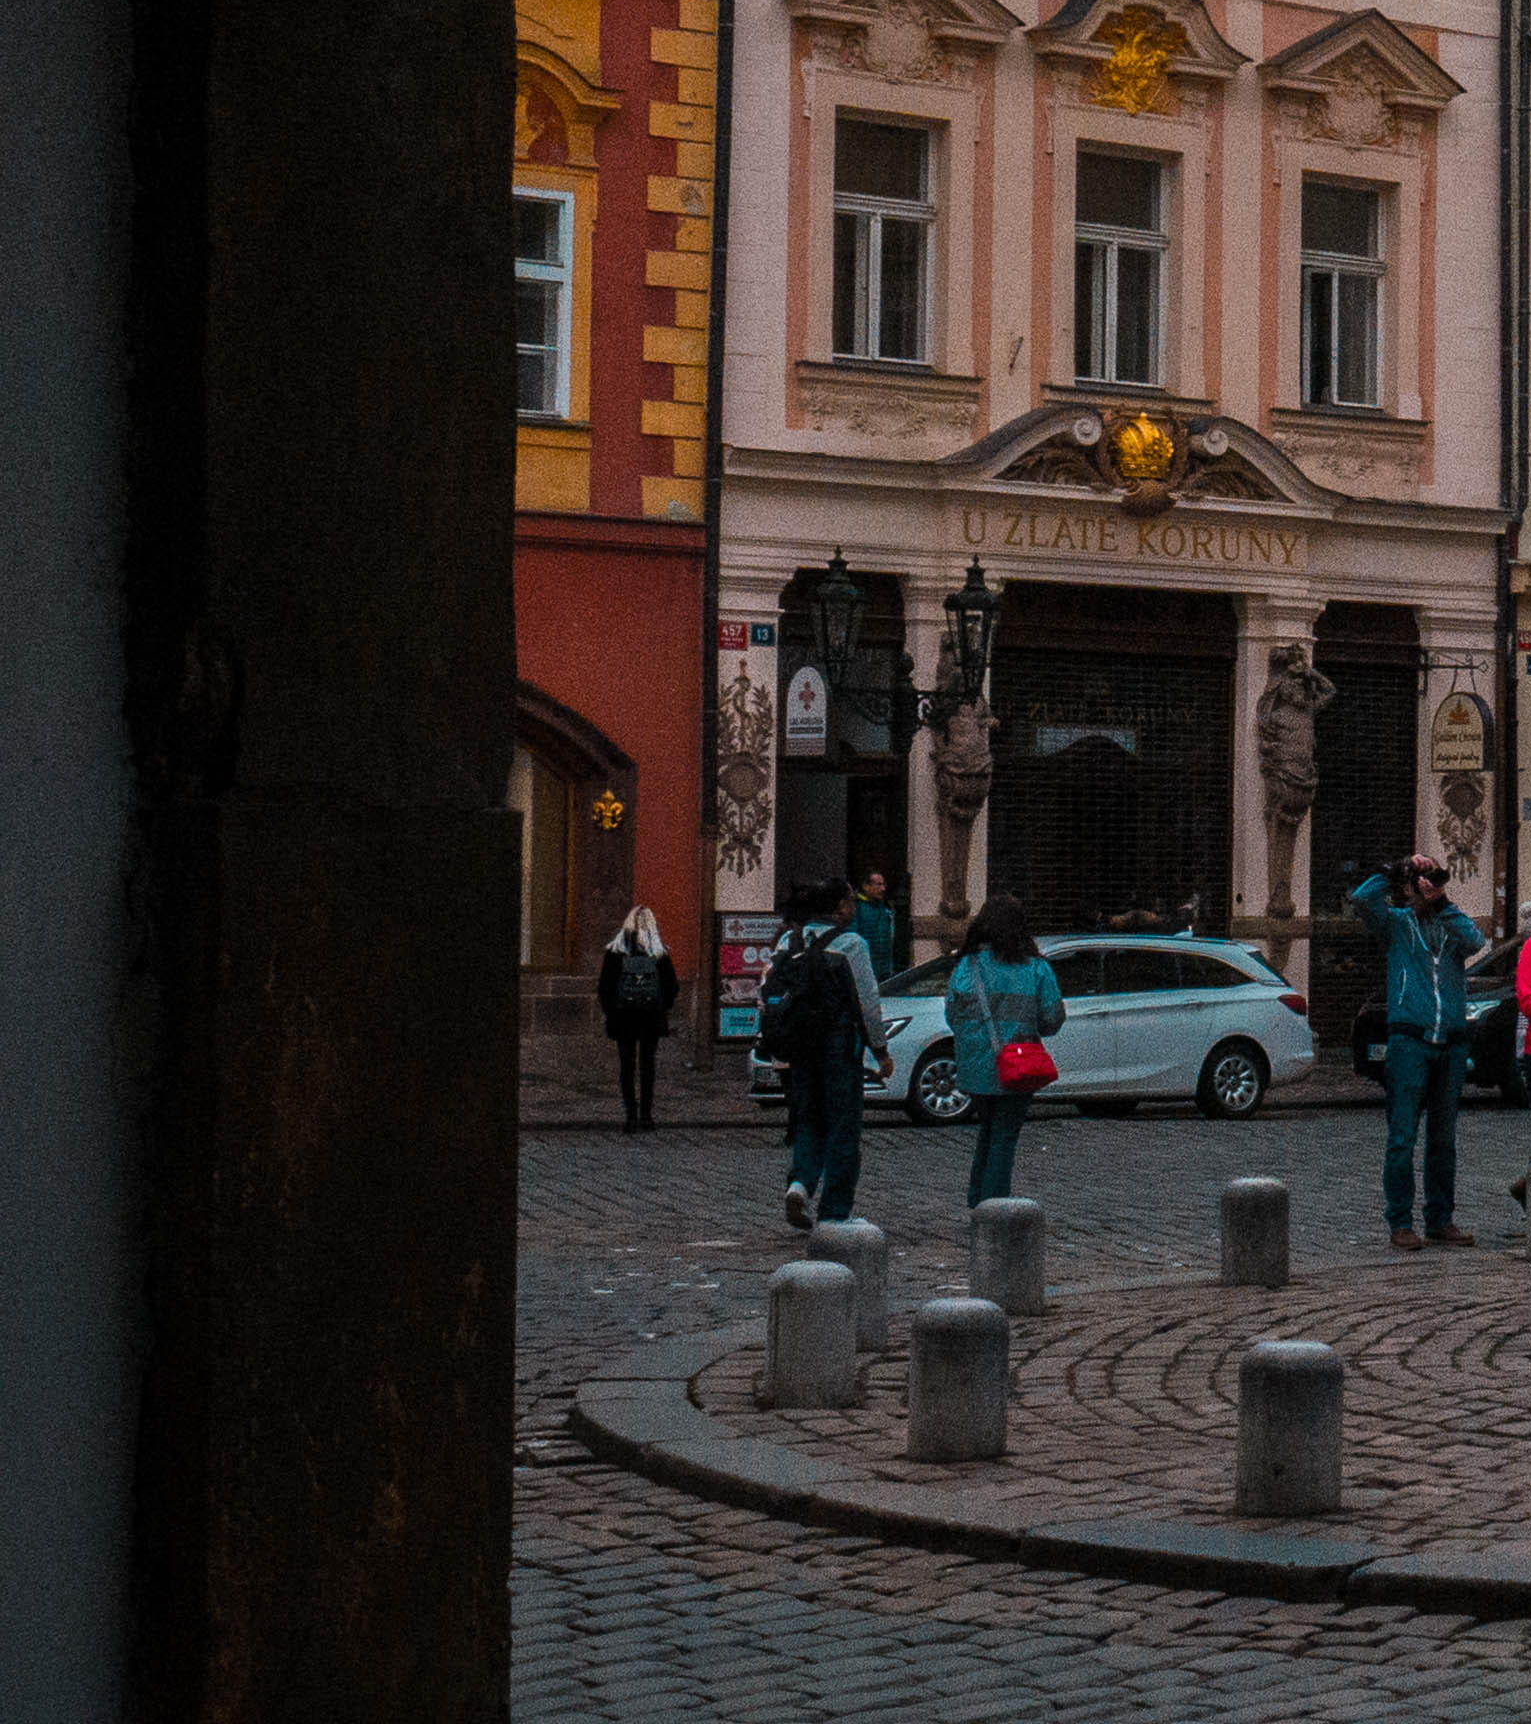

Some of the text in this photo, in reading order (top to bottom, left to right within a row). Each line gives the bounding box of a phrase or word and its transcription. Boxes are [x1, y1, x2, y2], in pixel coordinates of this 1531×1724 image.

[963, 510, 1299, 565] U ZLATÉ KORUNY
[722, 624, 742, 636] 457
[756, 627, 769, 641] 13
